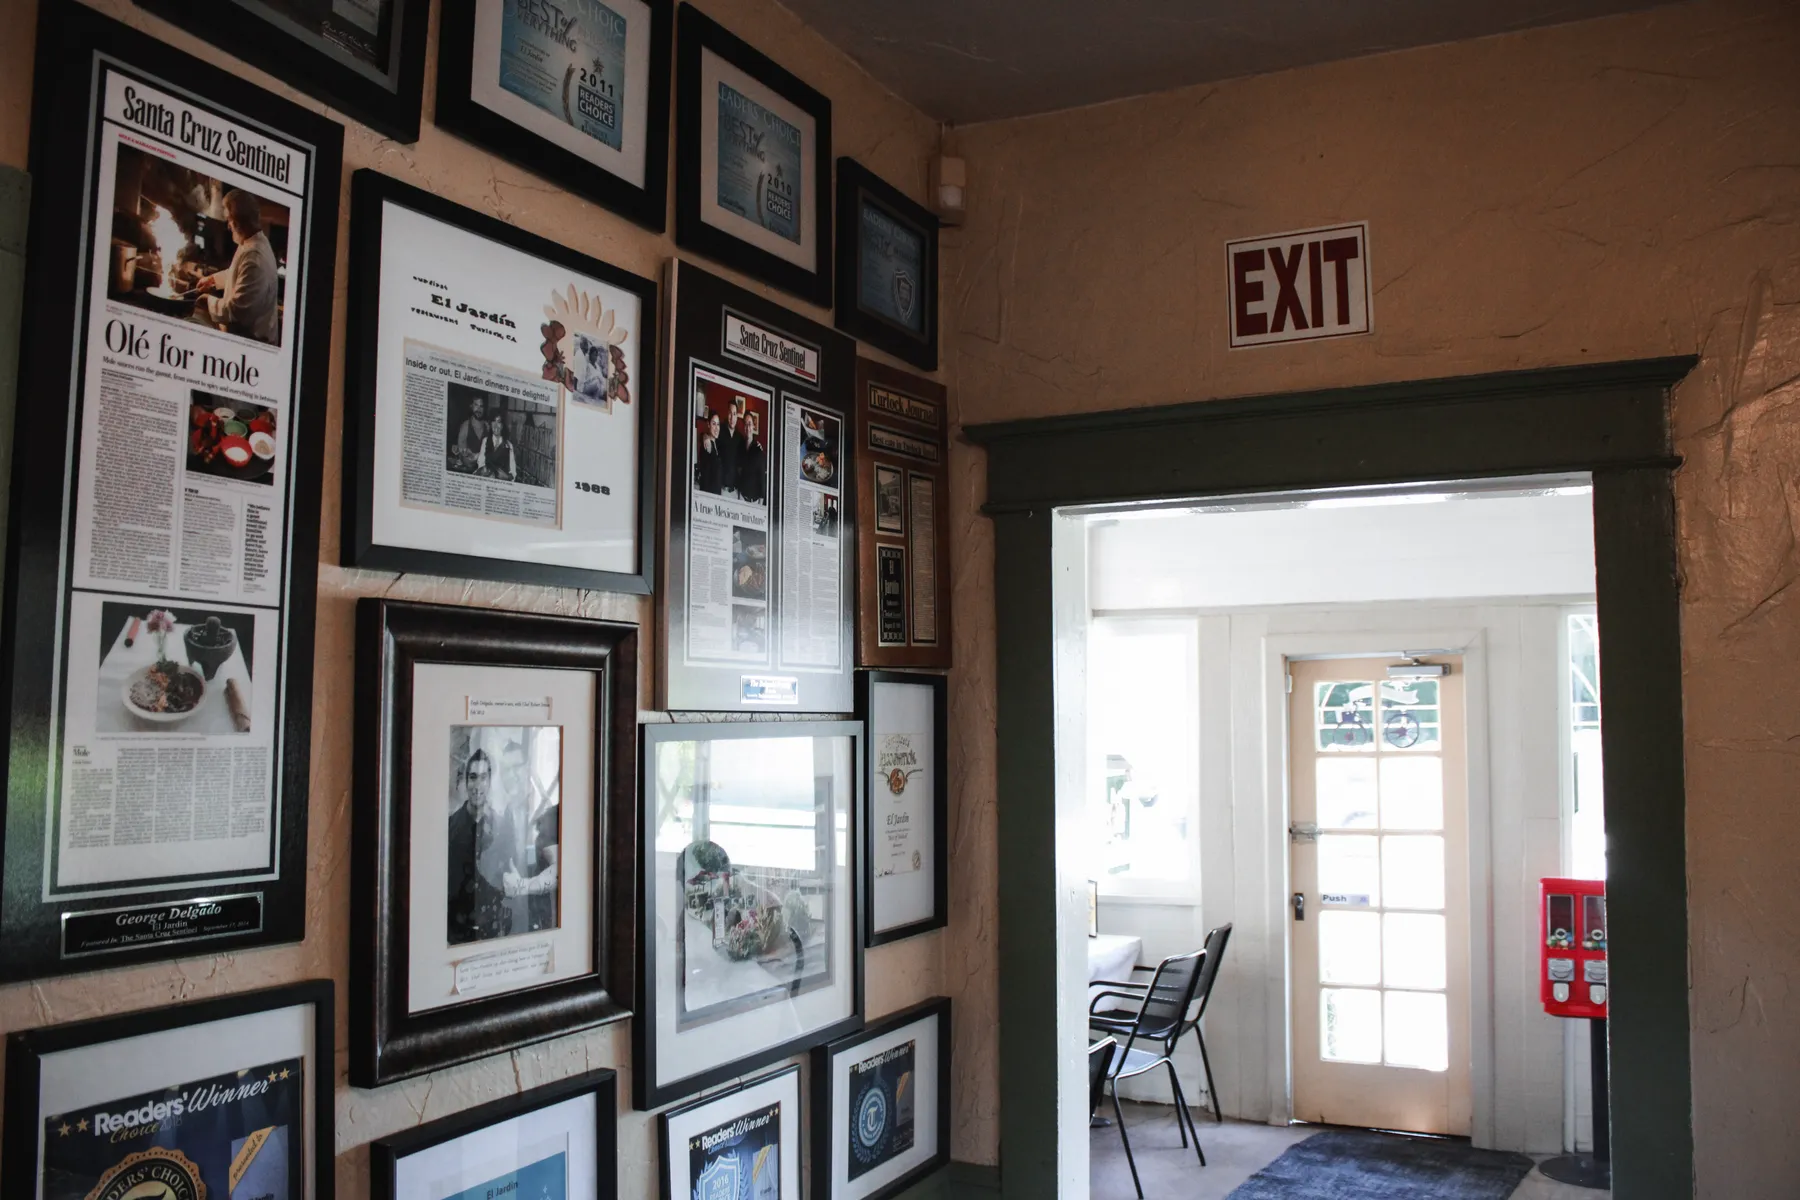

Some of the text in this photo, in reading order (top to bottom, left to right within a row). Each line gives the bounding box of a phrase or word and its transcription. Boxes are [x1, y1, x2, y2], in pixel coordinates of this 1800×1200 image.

[579, 67, 614, 97] 2011
[579, 89, 613, 114] READERS
[579, 100, 614, 127] CHOICE
[123, 86, 290, 185] Santa Cruz Sentinel
[768, 173, 792, 196] 2010
[767, 200, 792, 220] CHOICE
[1234, 236, 1359, 337] EXIT
[431, 293, 451, 309] El
[105, 319, 149, 359] Olé
[159, 333, 194, 370] for
[202, 353, 259, 387] mole
[739, 324, 806, 370] Santa Cruz Sentinel
[405, 357, 427, 370] Inside
[429, 364, 437, 372] or
[454, 370, 462, 379] El
[463, 373, 484, 385] Jardin
[485, 377, 510, 392] dinners
[511, 386, 521, 395] are
[522, 387, 550, 402] delightful
[574, 481, 611, 496] 1988
[714, 504, 739, 521] Mexican
[1322, 894, 1347, 902] Push
[115, 902, 222, 928] George Delgado
[152, 920, 188, 931] El Jardin
[120, 934, 134, 943] The
[135, 931, 153, 940] Santa
[155, 930, 171, 938] Cruz
[172, 926, 198, 936] Sentinel
[884, 1045, 909, 1063] Winner
[94, 1079, 270, 1136] Readers' Winner
[109, 1122, 160, 1144] Choice
[701, 1114, 770, 1151] Readers' Winner
[486, 1181, 519, 1200] El Jardin
[712, 1173, 729, 1190] 2016
